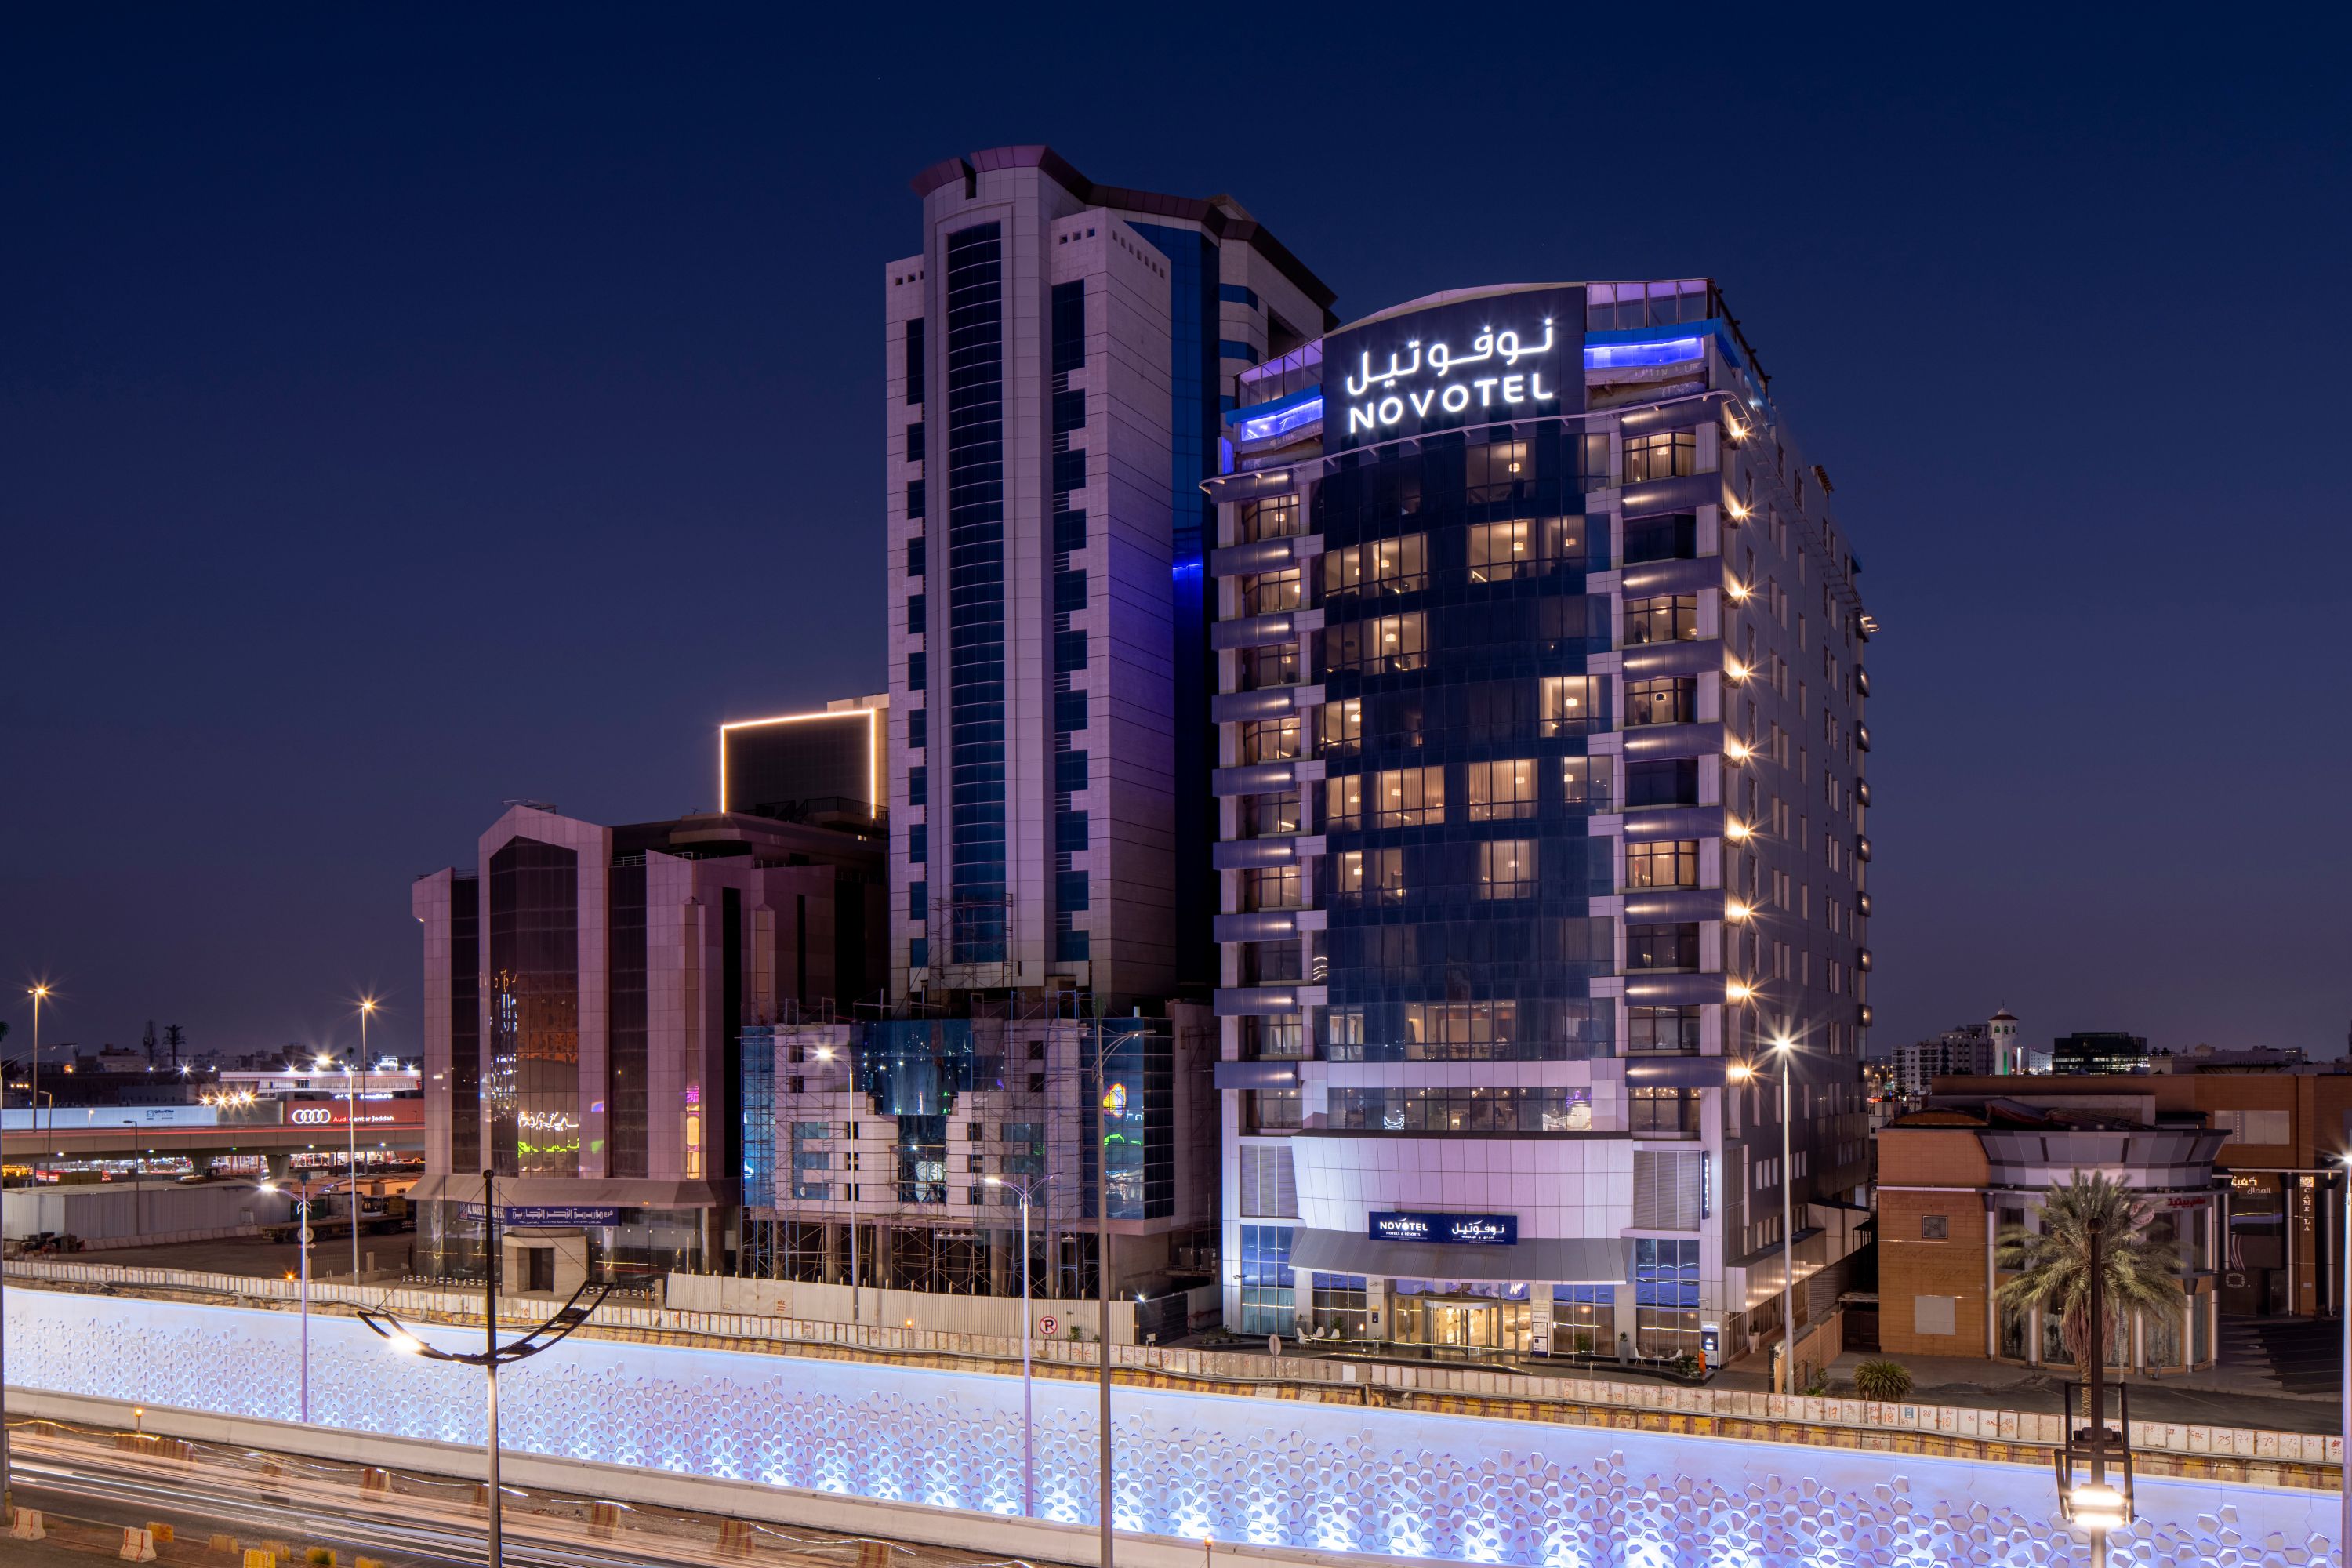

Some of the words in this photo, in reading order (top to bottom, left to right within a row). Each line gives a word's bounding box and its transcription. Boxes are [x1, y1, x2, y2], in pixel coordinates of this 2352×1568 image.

[1347, 317, 1553, 396] نوفوتيل
[1348, 372, 1554, 434] NOVOTEL
[1380, 1218, 1428, 1231] NOVOTEL
[1452, 1220, 1504, 1236] نوفوتيل
[1045, 1319, 1054, 1331] P
[1884, 1413, 1893, 1423] 18
[2217, 1436, 2231, 1445] 75
